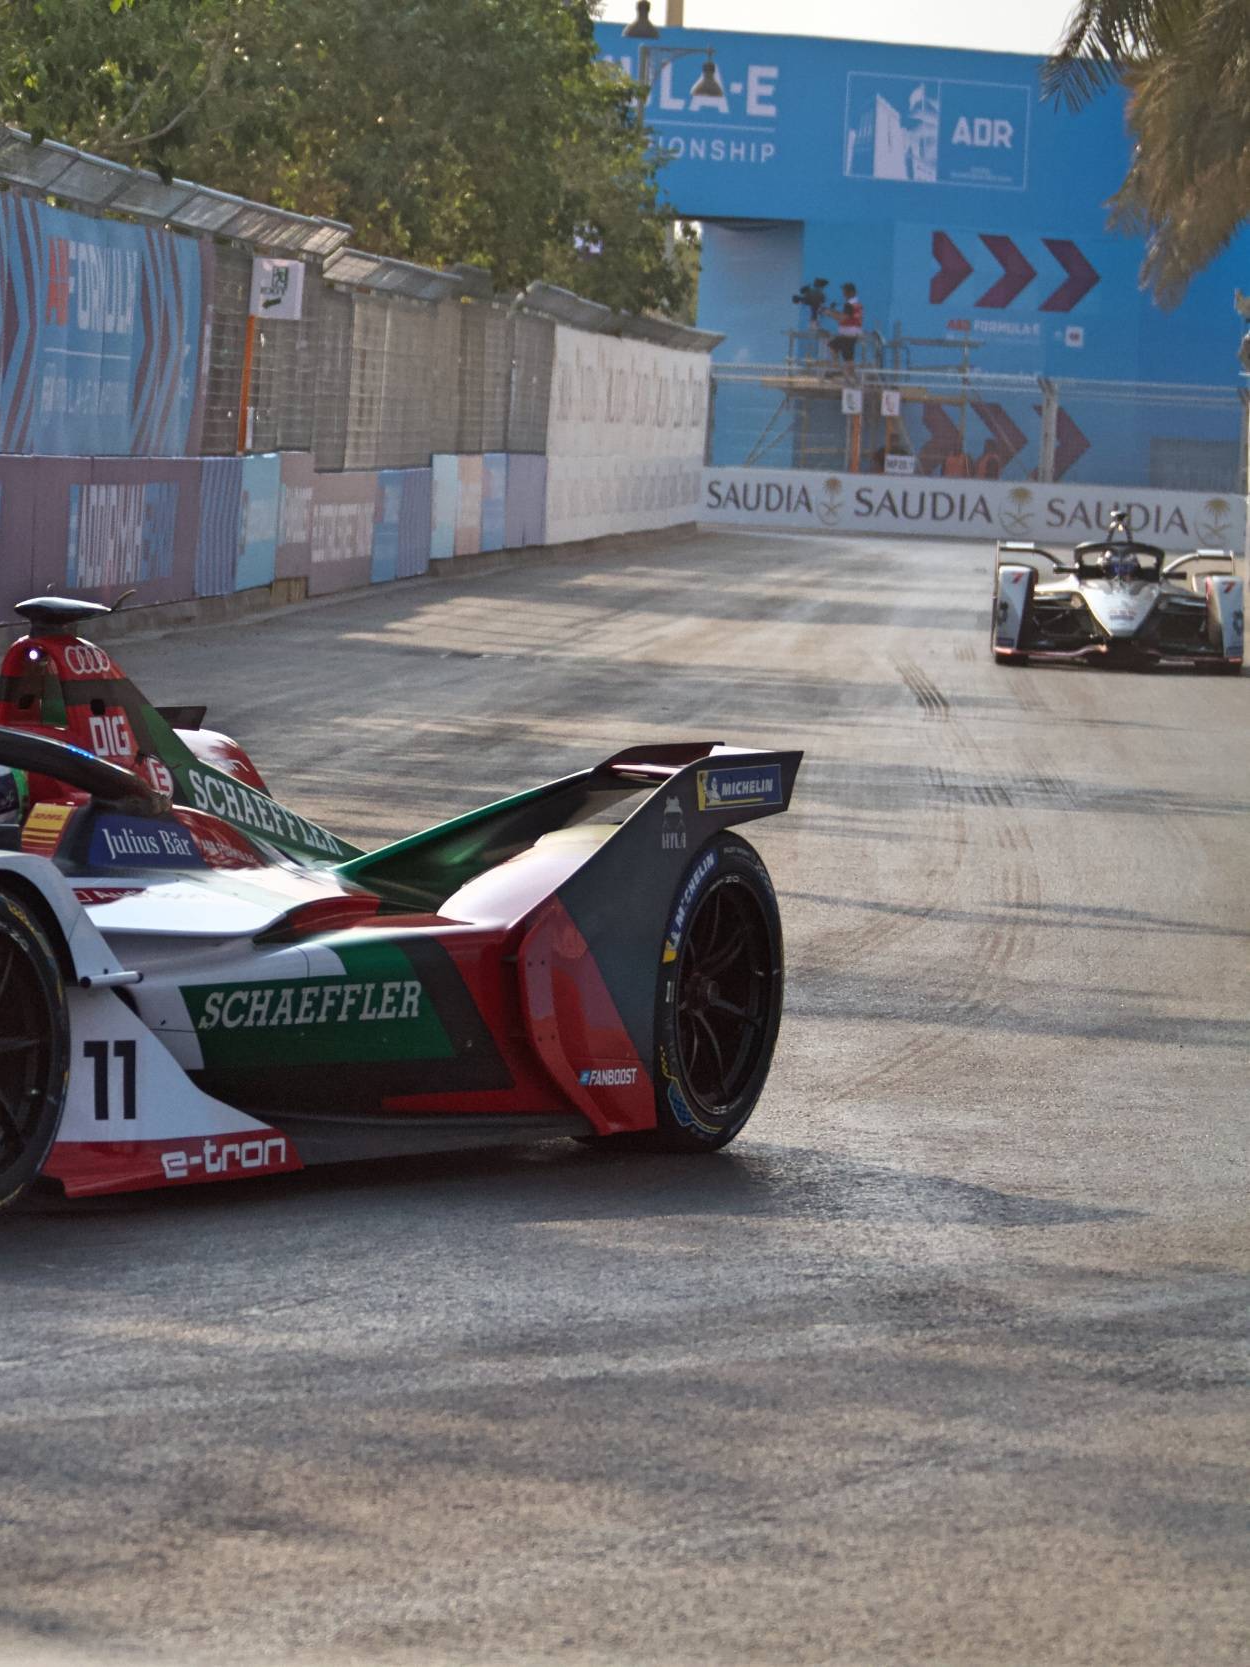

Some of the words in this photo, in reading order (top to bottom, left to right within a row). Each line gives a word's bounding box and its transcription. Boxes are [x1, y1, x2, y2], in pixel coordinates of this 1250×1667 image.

[645, 135, 776, 163] IONSHIP
[951, 115, 1014, 149] ADR
[706, 479, 813, 514] SAUDIA
[854, 487, 993, 524] SAUDIA
[721, 778, 774, 797] MICHELIN
[188, 769, 343, 857] SCHAEFFLER
[102, 828, 160, 860] Julius
[158, 829, 193, 857] Bär
[198, 980, 422, 1030] SCHAEFFLER
[83, 1039, 137, 1121] 11
[161, 1138, 286, 1179] e-tron
